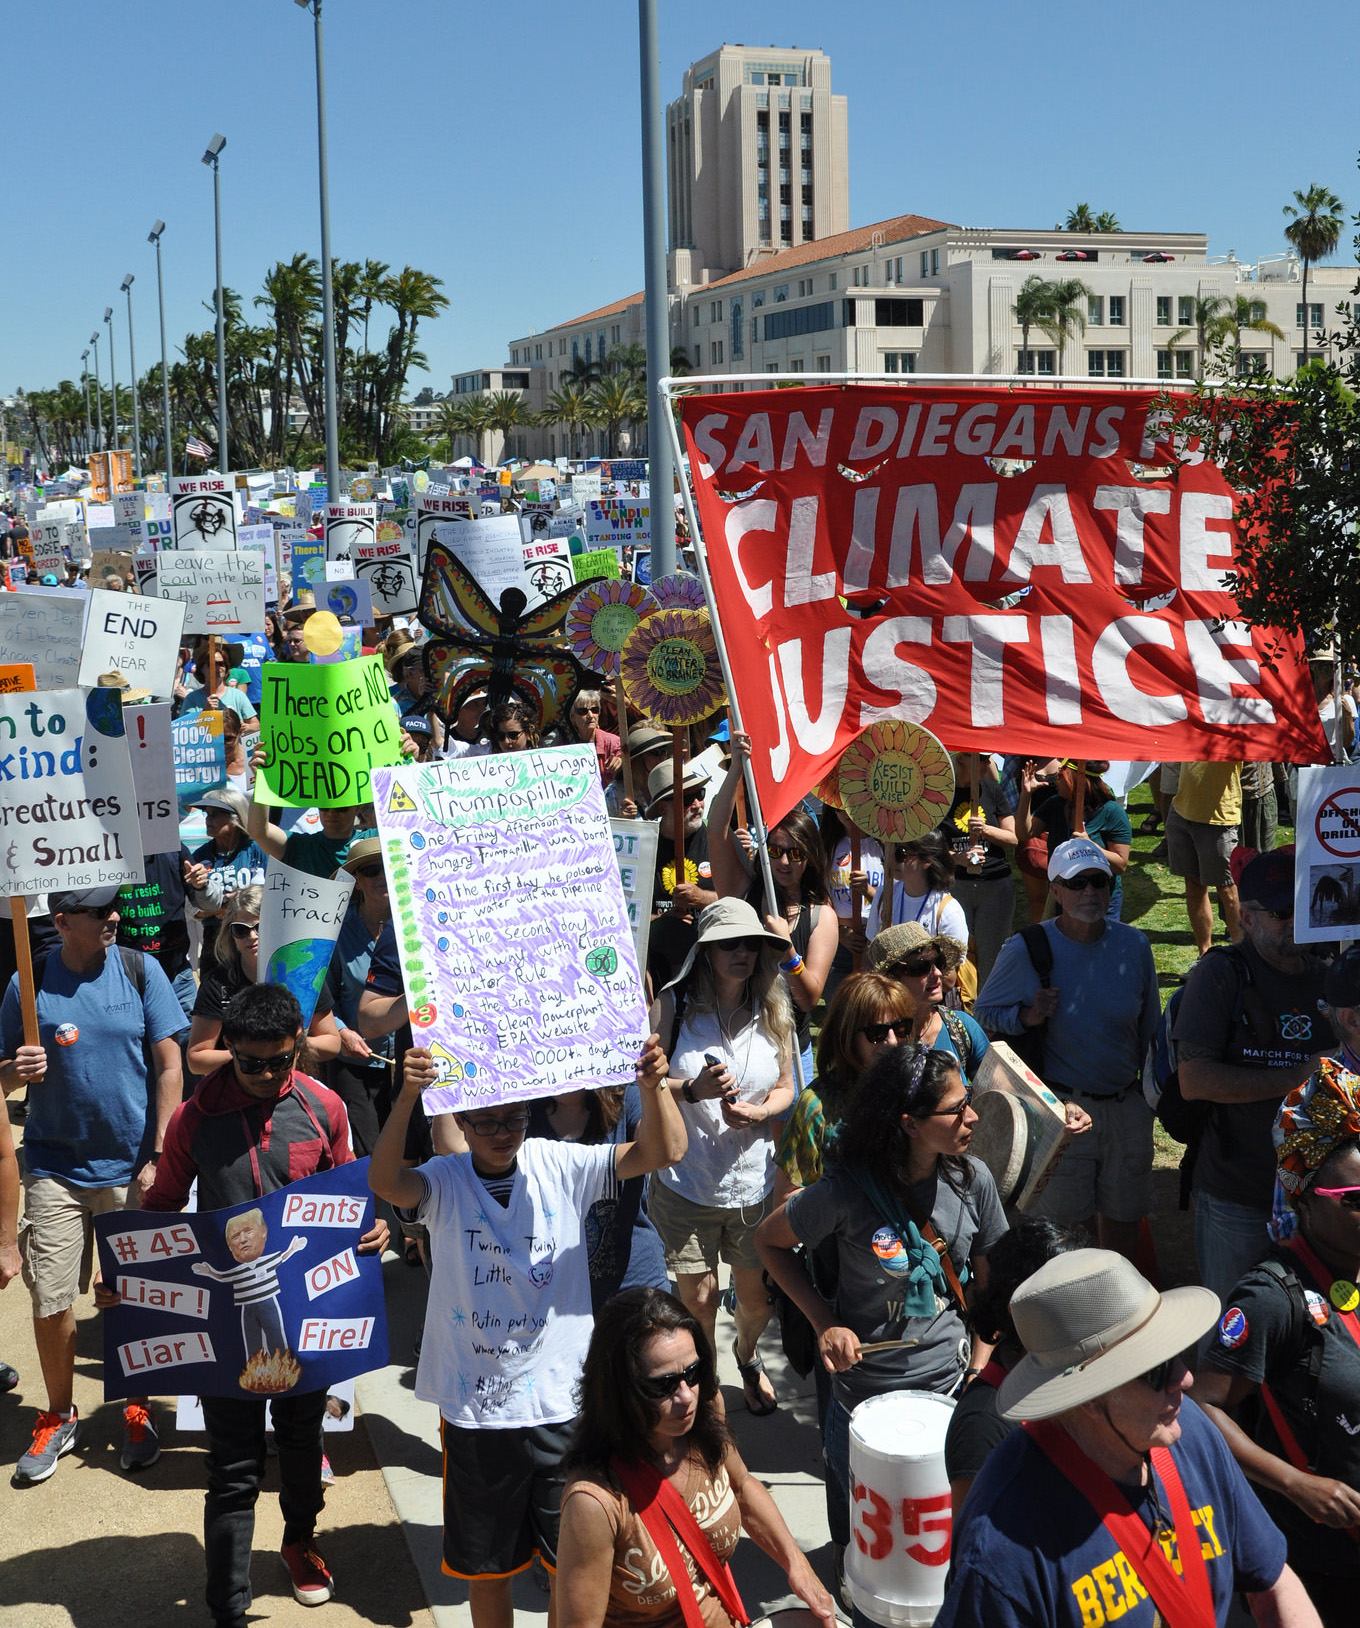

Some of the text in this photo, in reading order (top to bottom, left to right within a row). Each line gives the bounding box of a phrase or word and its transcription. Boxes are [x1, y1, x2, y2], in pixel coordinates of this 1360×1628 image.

[693, 402, 1126, 481] SAN DIEGANS
[179, 481, 224, 493] WE RISE
[118, 495, 139, 503] MAKE
[423, 498, 439, 511] WE
[442, 501, 469, 512] RISE
[590, 500, 626, 511] STILL
[329, 507, 373, 517] WE BUILD
[595, 508, 650, 520] STANDIN
[32, 526, 59, 541] NO TO
[611, 518, 643, 529] WITH
[588, 533, 631, 542] STANDING
[358, 544, 401, 558] WE RISE
[535, 543, 559, 556] RISE
[586, 553, 609, 567] EARTH
[724, 482, 1238, 620] CLIMATE
[36, 558, 60, 570] GREED
[159, 554, 215, 571] Leave
[223, 554, 259, 573] the
[160, 572, 263, 585] coal in the hole
[127, 601, 151, 612] THE
[176, 589, 257, 605] the oil in
[6, 624, 25, 641] of
[103, 612, 158, 639] END
[124, 641, 135, 650] IS
[660, 645, 691, 657] CLEAN
[108, 655, 147, 671] NEAR
[651, 666, 705, 681] NO BRAINER
[663, 657, 698, 670] WATER
[267, 662, 390, 718] There are NO
[768, 615, 1277, 783] JUSTICE
[24, 701, 66, 738] to
[405, 720, 427, 730] FACTS
[172, 725, 213, 746] 100%
[265, 719, 389, 769] jobs on a
[0, 736, 98, 781] kind:
[172, 746, 216, 765] Clean
[174, 766, 221, 784] nergy
[430, 753, 598, 788] The Very Hungry
[873, 758, 914, 781] RESIST
[277, 761, 351, 800] DEAD
[873, 778, 911, 796] BUILD
[881, 792, 905, 803] RISE
[0, 792, 122, 827] reatures
[1320, 807, 1360, 819] OFFSH
[453, 826, 498, 846] Friday
[564, 813, 587, 825] the
[589, 813, 609, 825] very
[1321, 830, 1360, 840] DRILL
[32, 832, 124, 867] Small
[427, 826, 609, 872] hungry was born!
[0, 868, 138, 894] xtinction has begun
[134, 882, 165, 899] resist.
[268, 872, 320, 899] It is
[455, 872, 562, 898] the first day he
[137, 902, 165, 918] build.
[474, 882, 602, 917] water with the pipeline
[464, 911, 616, 945] the second day he
[452, 933, 617, 977] did away Clean
[455, 965, 548, 994] Water Rule
[480, 996, 501, 1012] the
[508, 992, 531, 1009] 3rd
[540, 989, 566, 1008] day
[577, 980, 598, 996] he
[464, 993, 637, 1037] the Clean off
[465, 1030, 530, 1052] the EPA
[495, 1042, 615, 1071] the 1000th day
[1242, 1048, 1302, 1059] MARCH FOR
[463, 1062, 602, 1098] was no world left to
[285, 1194, 360, 1224] Pants
[149, 1227, 195, 1258] 45
[311, 1254, 354, 1292] ON
[473, 1263, 512, 1286] Little
[471, 1309, 501, 1330] Putin
[508, 1313, 527, 1333] put
[302, 1319, 368, 1350] Fire!
